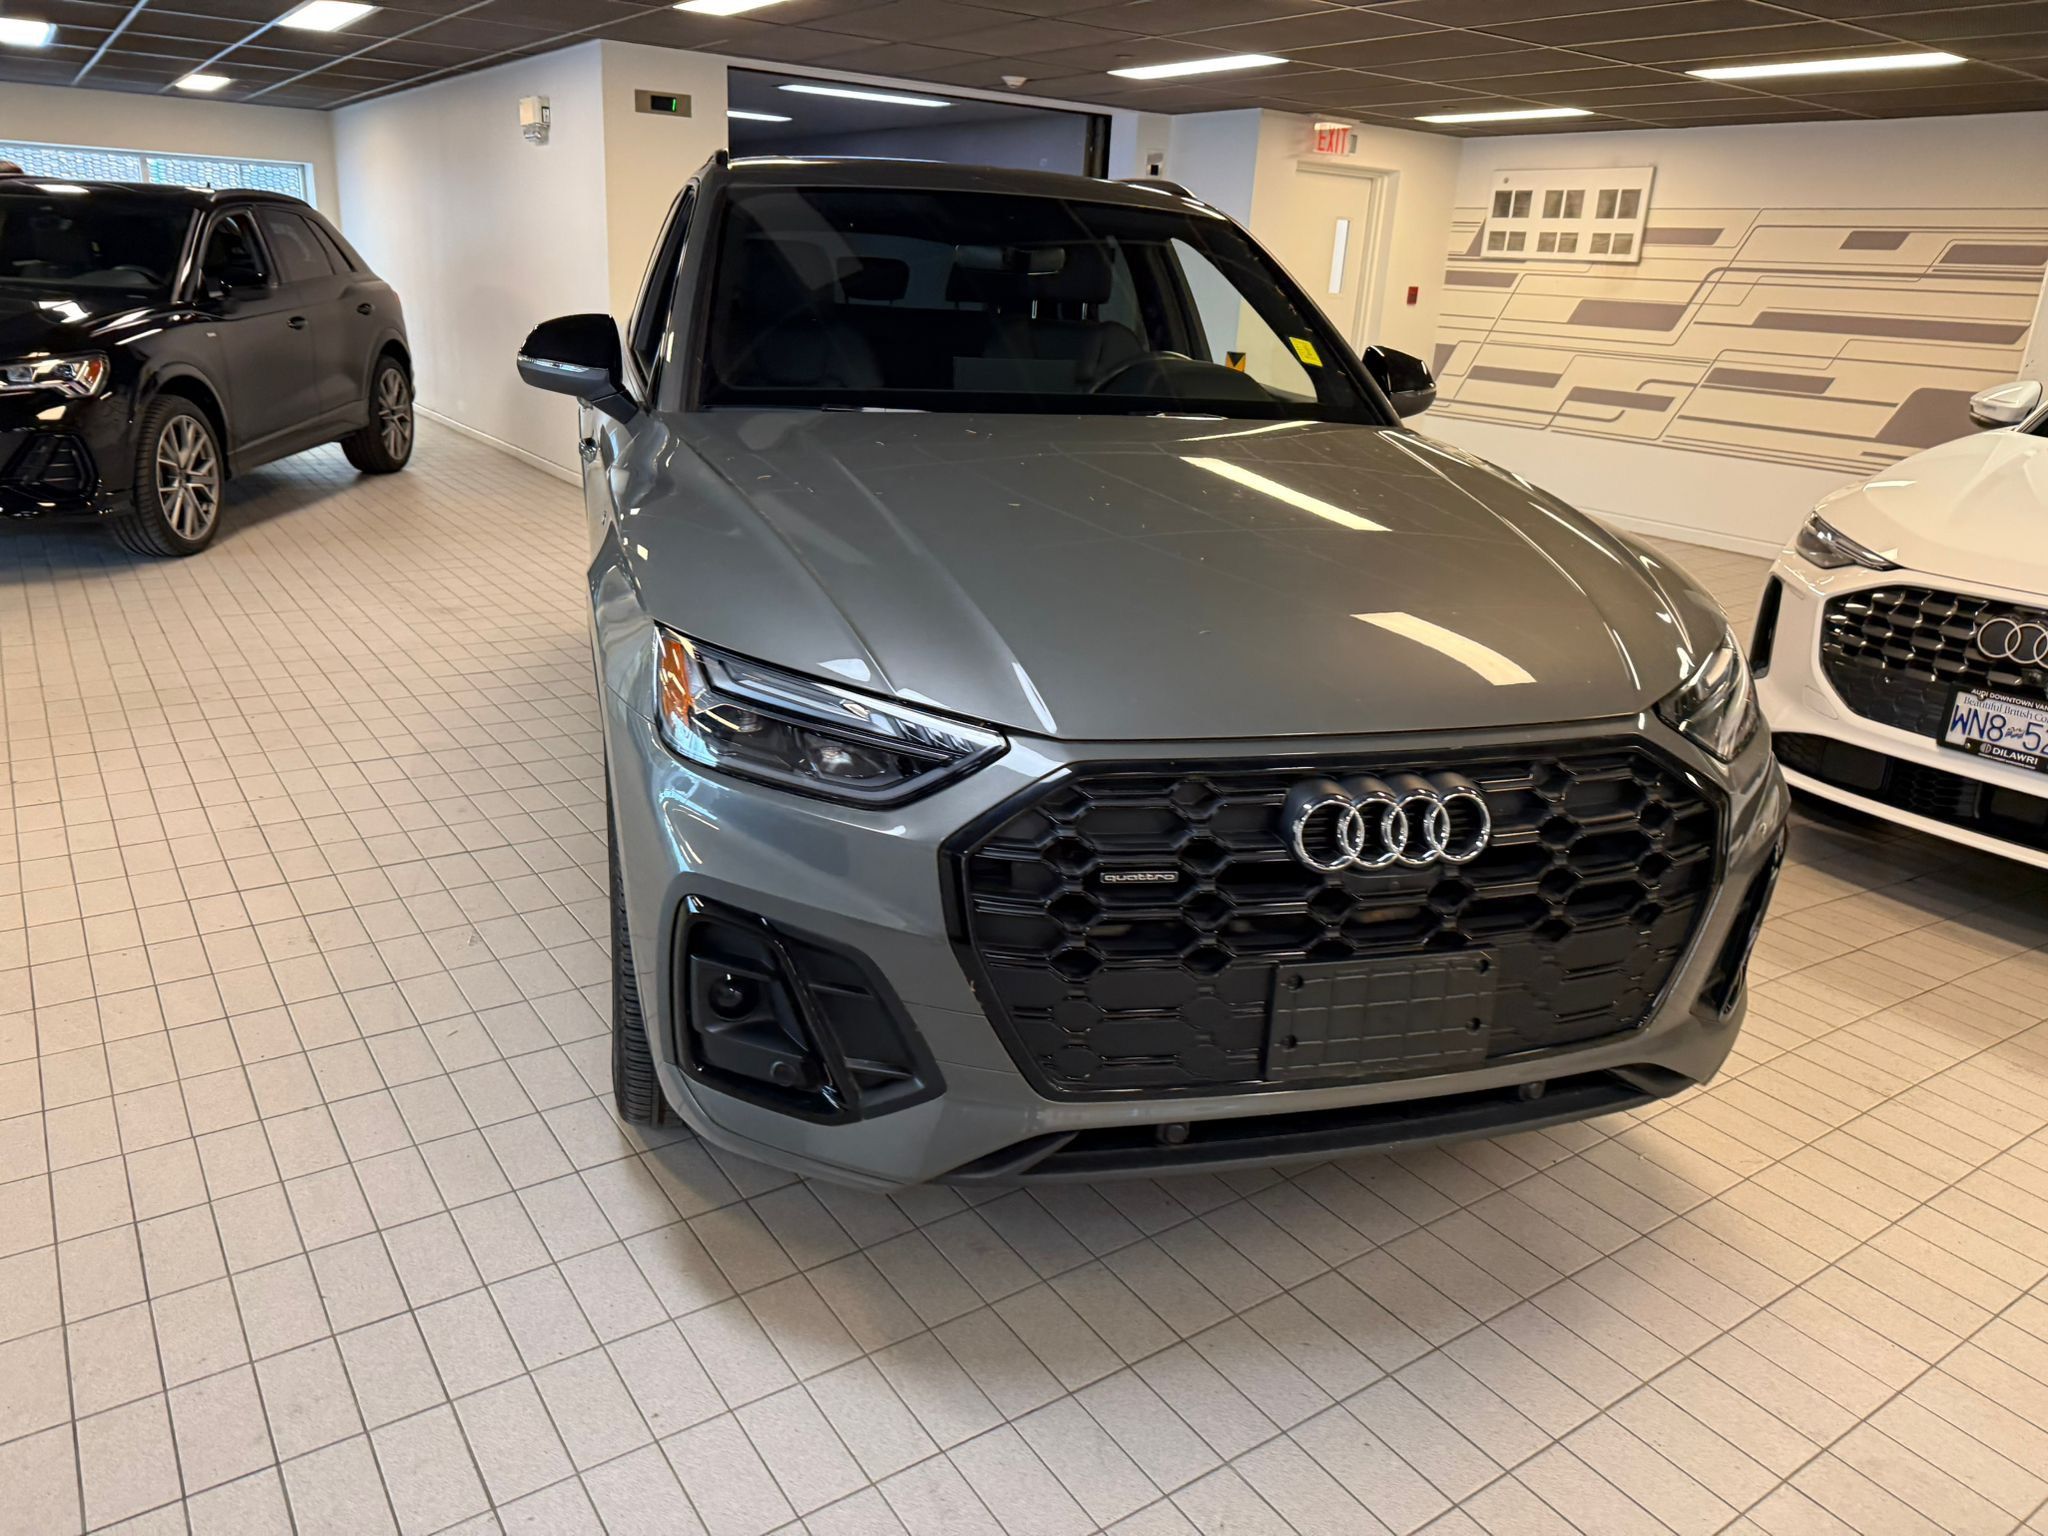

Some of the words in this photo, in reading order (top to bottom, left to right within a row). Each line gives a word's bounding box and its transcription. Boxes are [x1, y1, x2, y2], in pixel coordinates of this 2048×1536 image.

[1317, 128, 1349, 153] EXIT
[1964, 696, 2003, 712] Beautiful
[2004, 705, 2032, 720] British
[1971, 688, 1989, 698] AUDI
[1989, 692, 2034, 709] DOWNTOWN
[1951, 705, 2006, 742] WN8
[1992, 747, 2039, 765] DILAWRI
[1104, 874, 1175, 882] quattro
